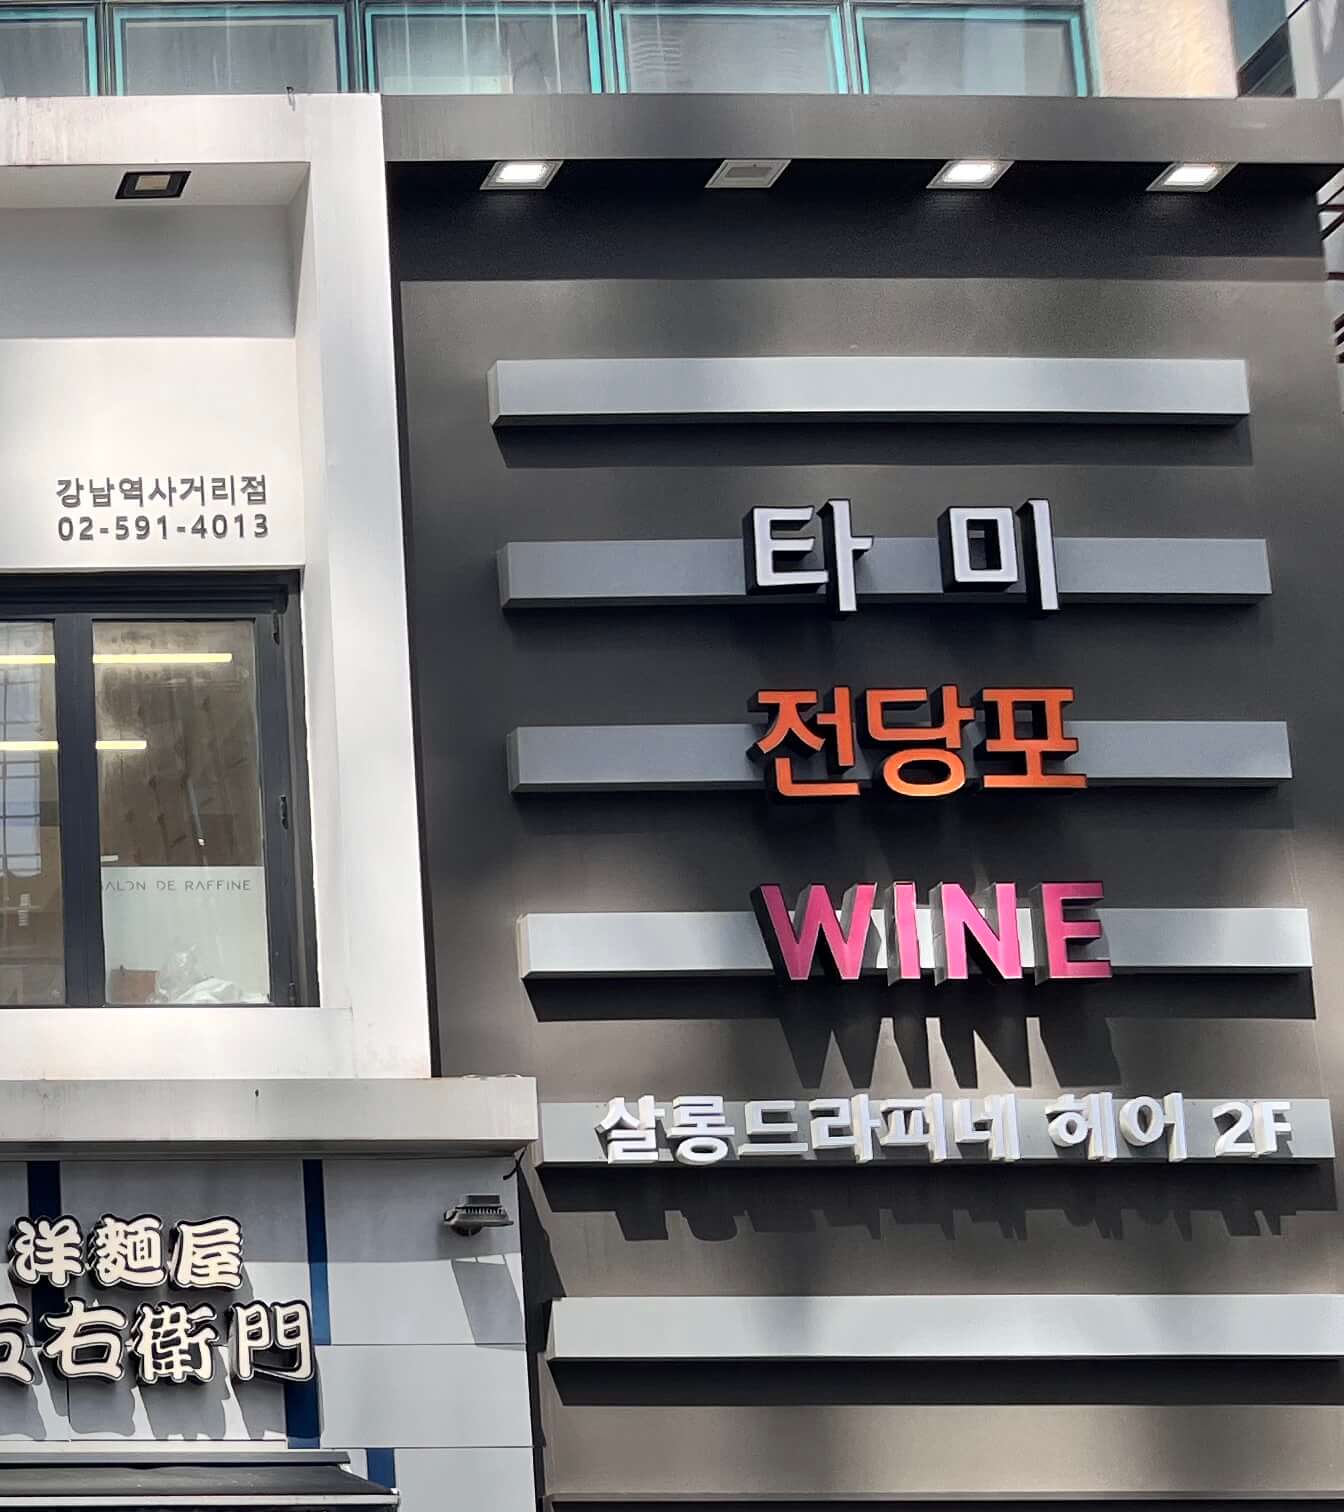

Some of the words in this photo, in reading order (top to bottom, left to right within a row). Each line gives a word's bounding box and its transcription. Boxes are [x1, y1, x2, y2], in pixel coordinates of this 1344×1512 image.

[56, 474, 268, 508] 강남역사거리점
[57, 513, 269, 541] 02-591-4013
[750, 684, 1089, 798] 전당포
[185, 879, 251, 892] RAFFINE
[751, 881, 1113, 981] WINE
[1045, 1087, 1188, 1164] 헤어
[1211, 1096, 1293, 1158] 2F
